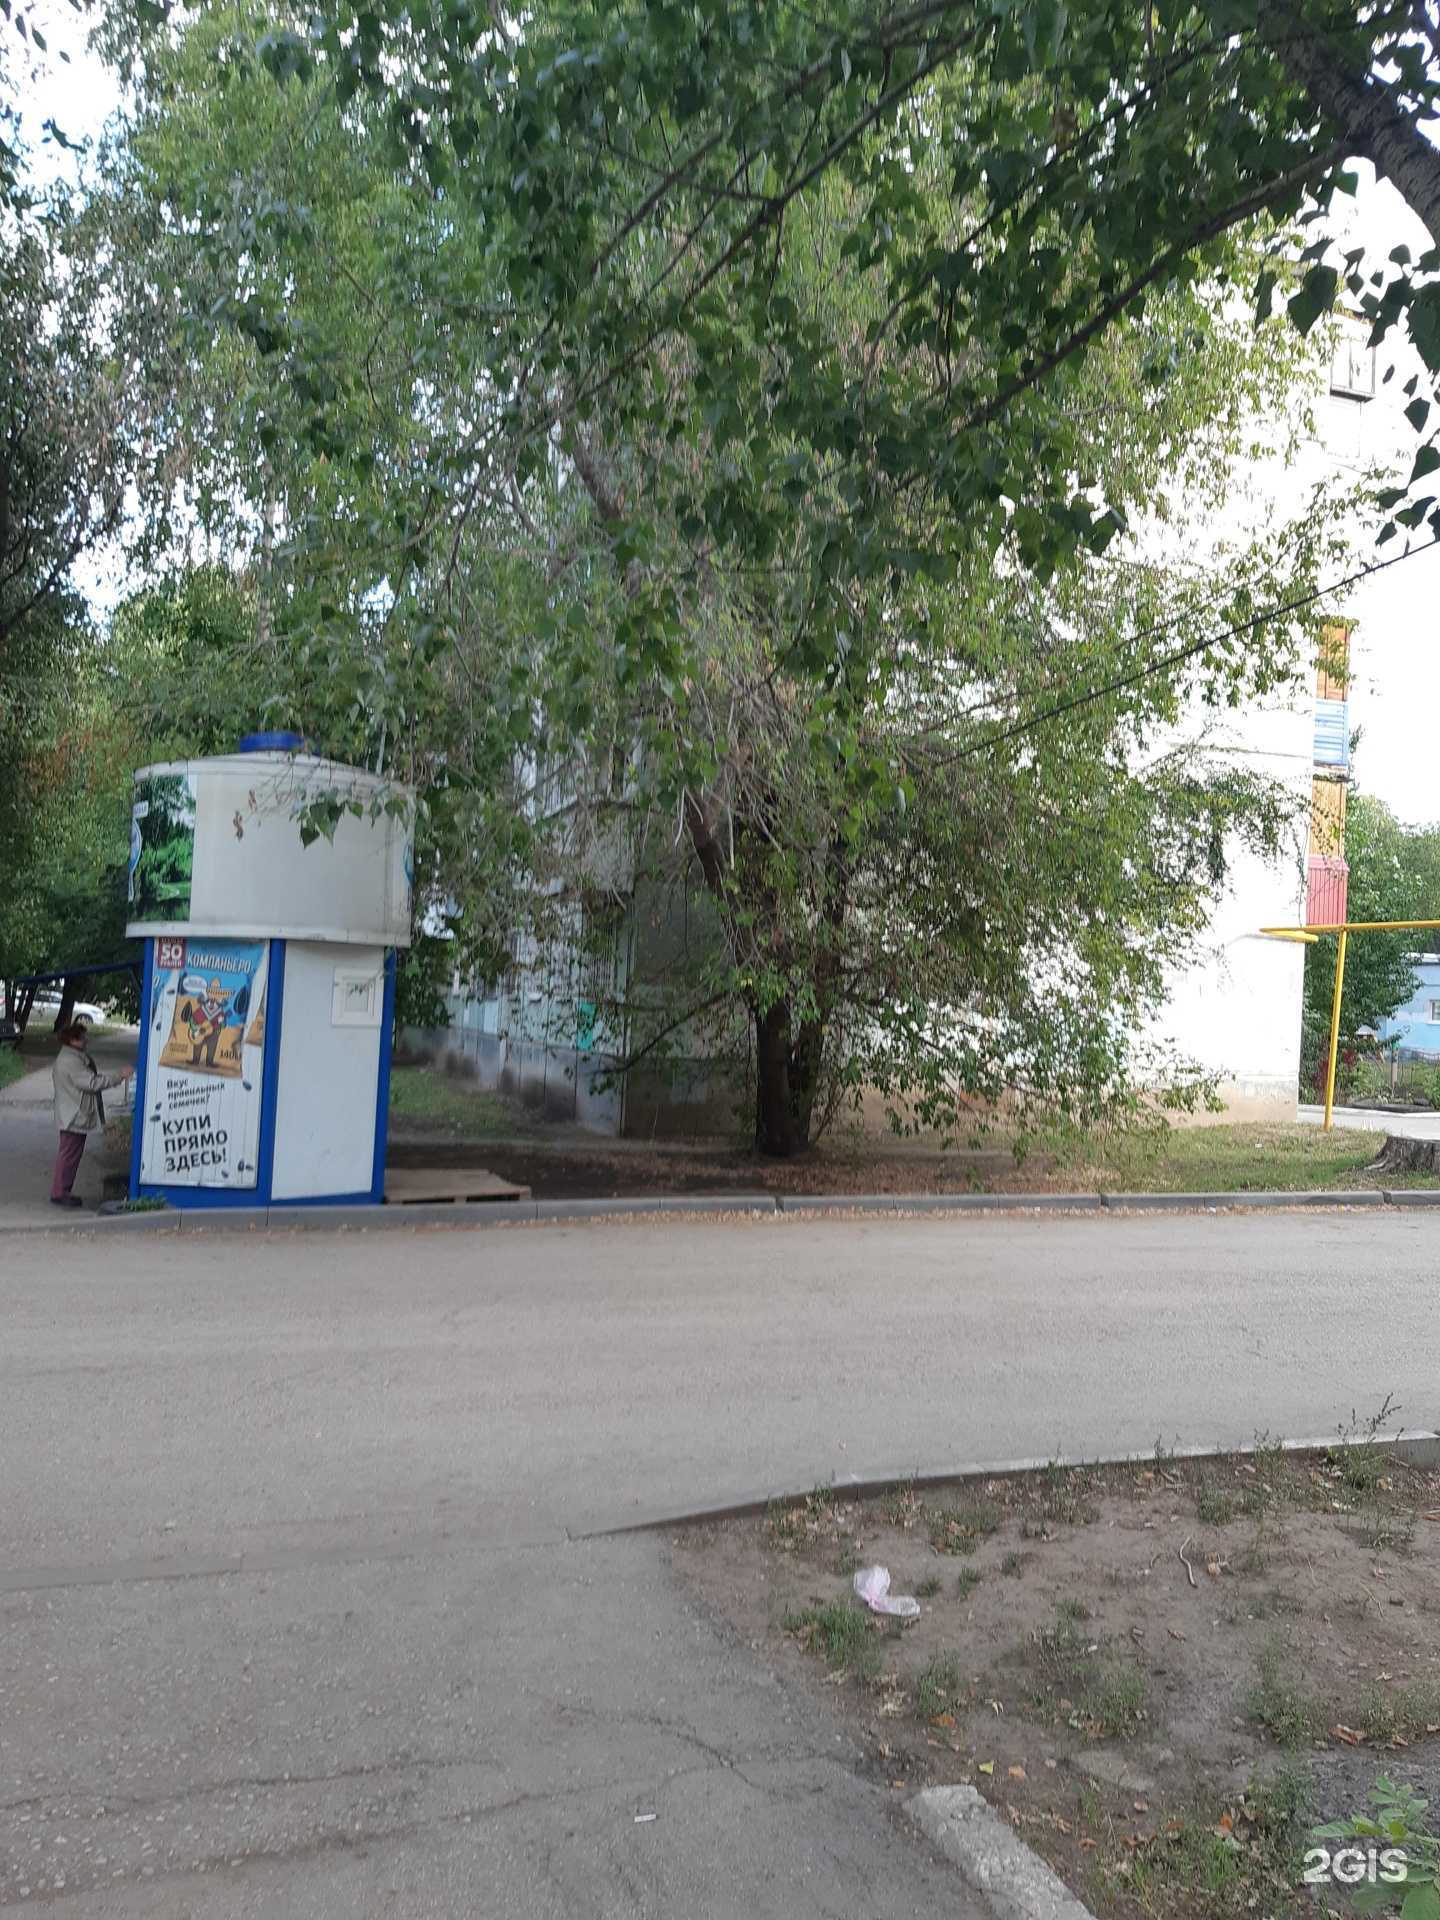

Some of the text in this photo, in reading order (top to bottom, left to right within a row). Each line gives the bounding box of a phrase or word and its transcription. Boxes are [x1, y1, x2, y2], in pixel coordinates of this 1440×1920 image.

[161, 943, 183, 961] 50
[167, 1078, 188, 1090] Вкус
[162, 1114, 211, 1136] КУПИ
[164, 1129, 228, 1154] ПРЯМО
[165, 1146, 226, 1173] ЗДЕСЬ!
